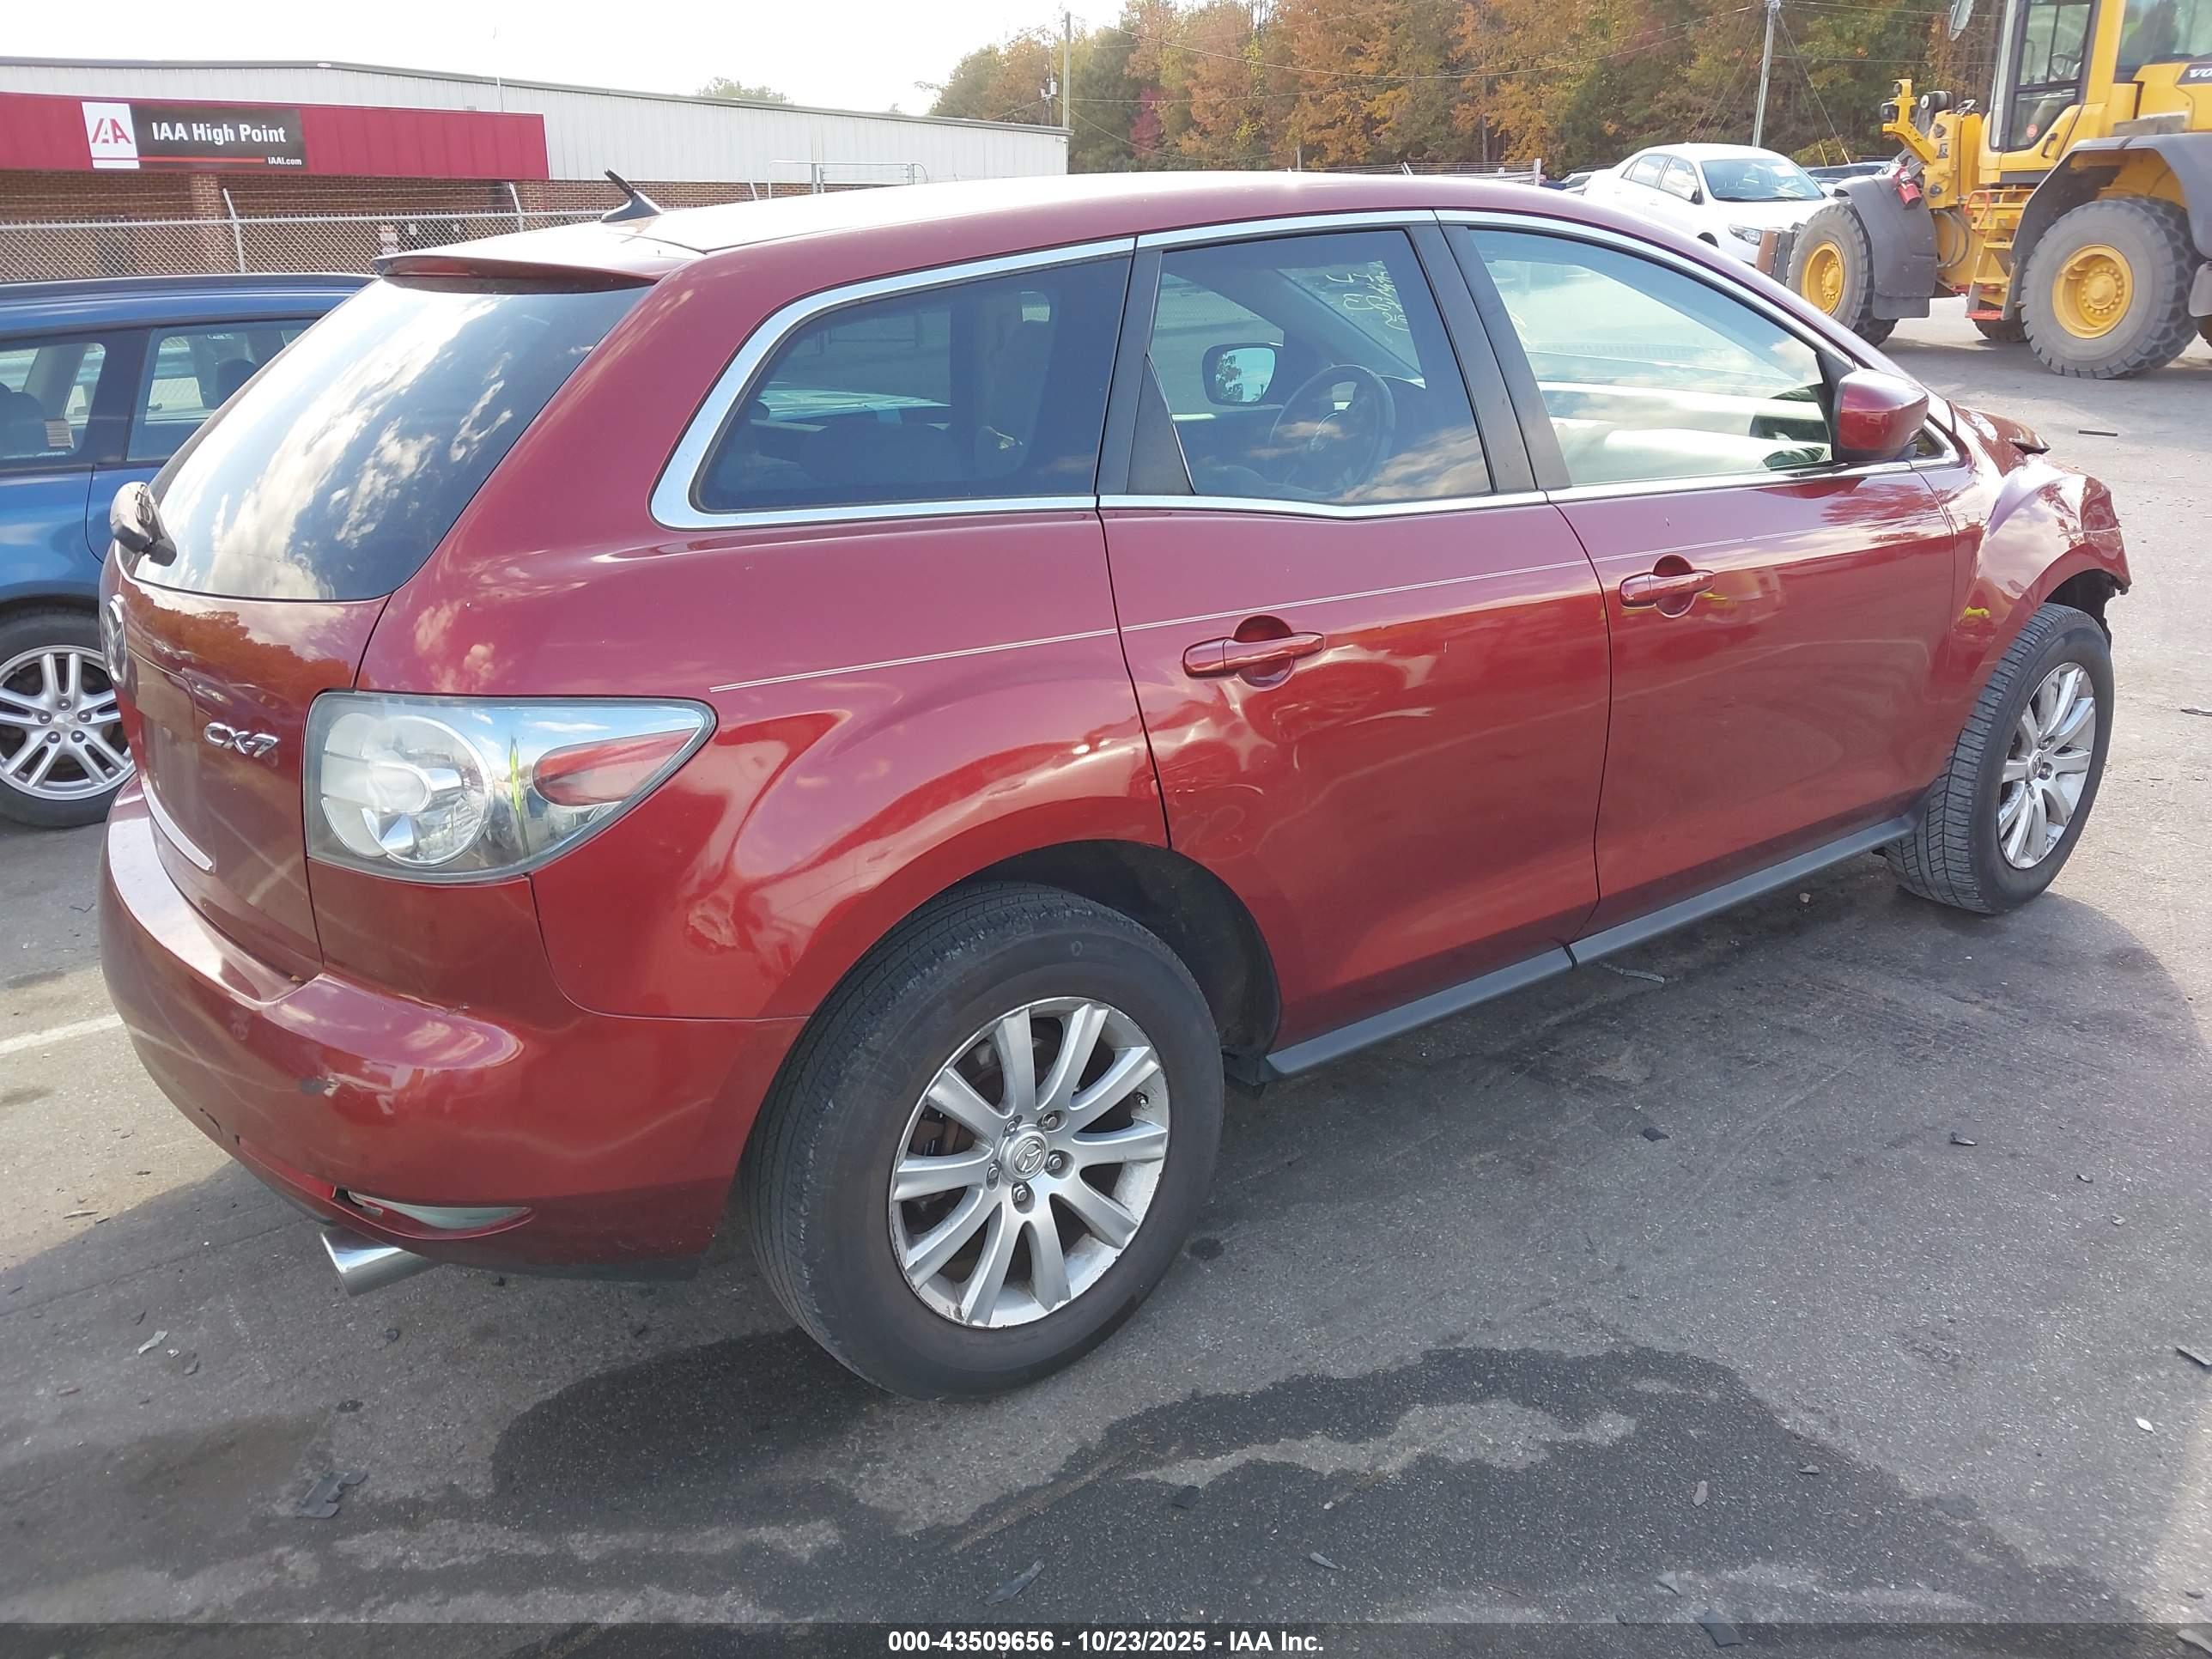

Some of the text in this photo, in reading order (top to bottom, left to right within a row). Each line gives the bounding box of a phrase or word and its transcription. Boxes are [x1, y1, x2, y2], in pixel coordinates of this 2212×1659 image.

[152, 122, 287, 145] IAA High Point
[268, 156, 302, 166] IAAI.com
[203, 722, 281, 757] CX-7
